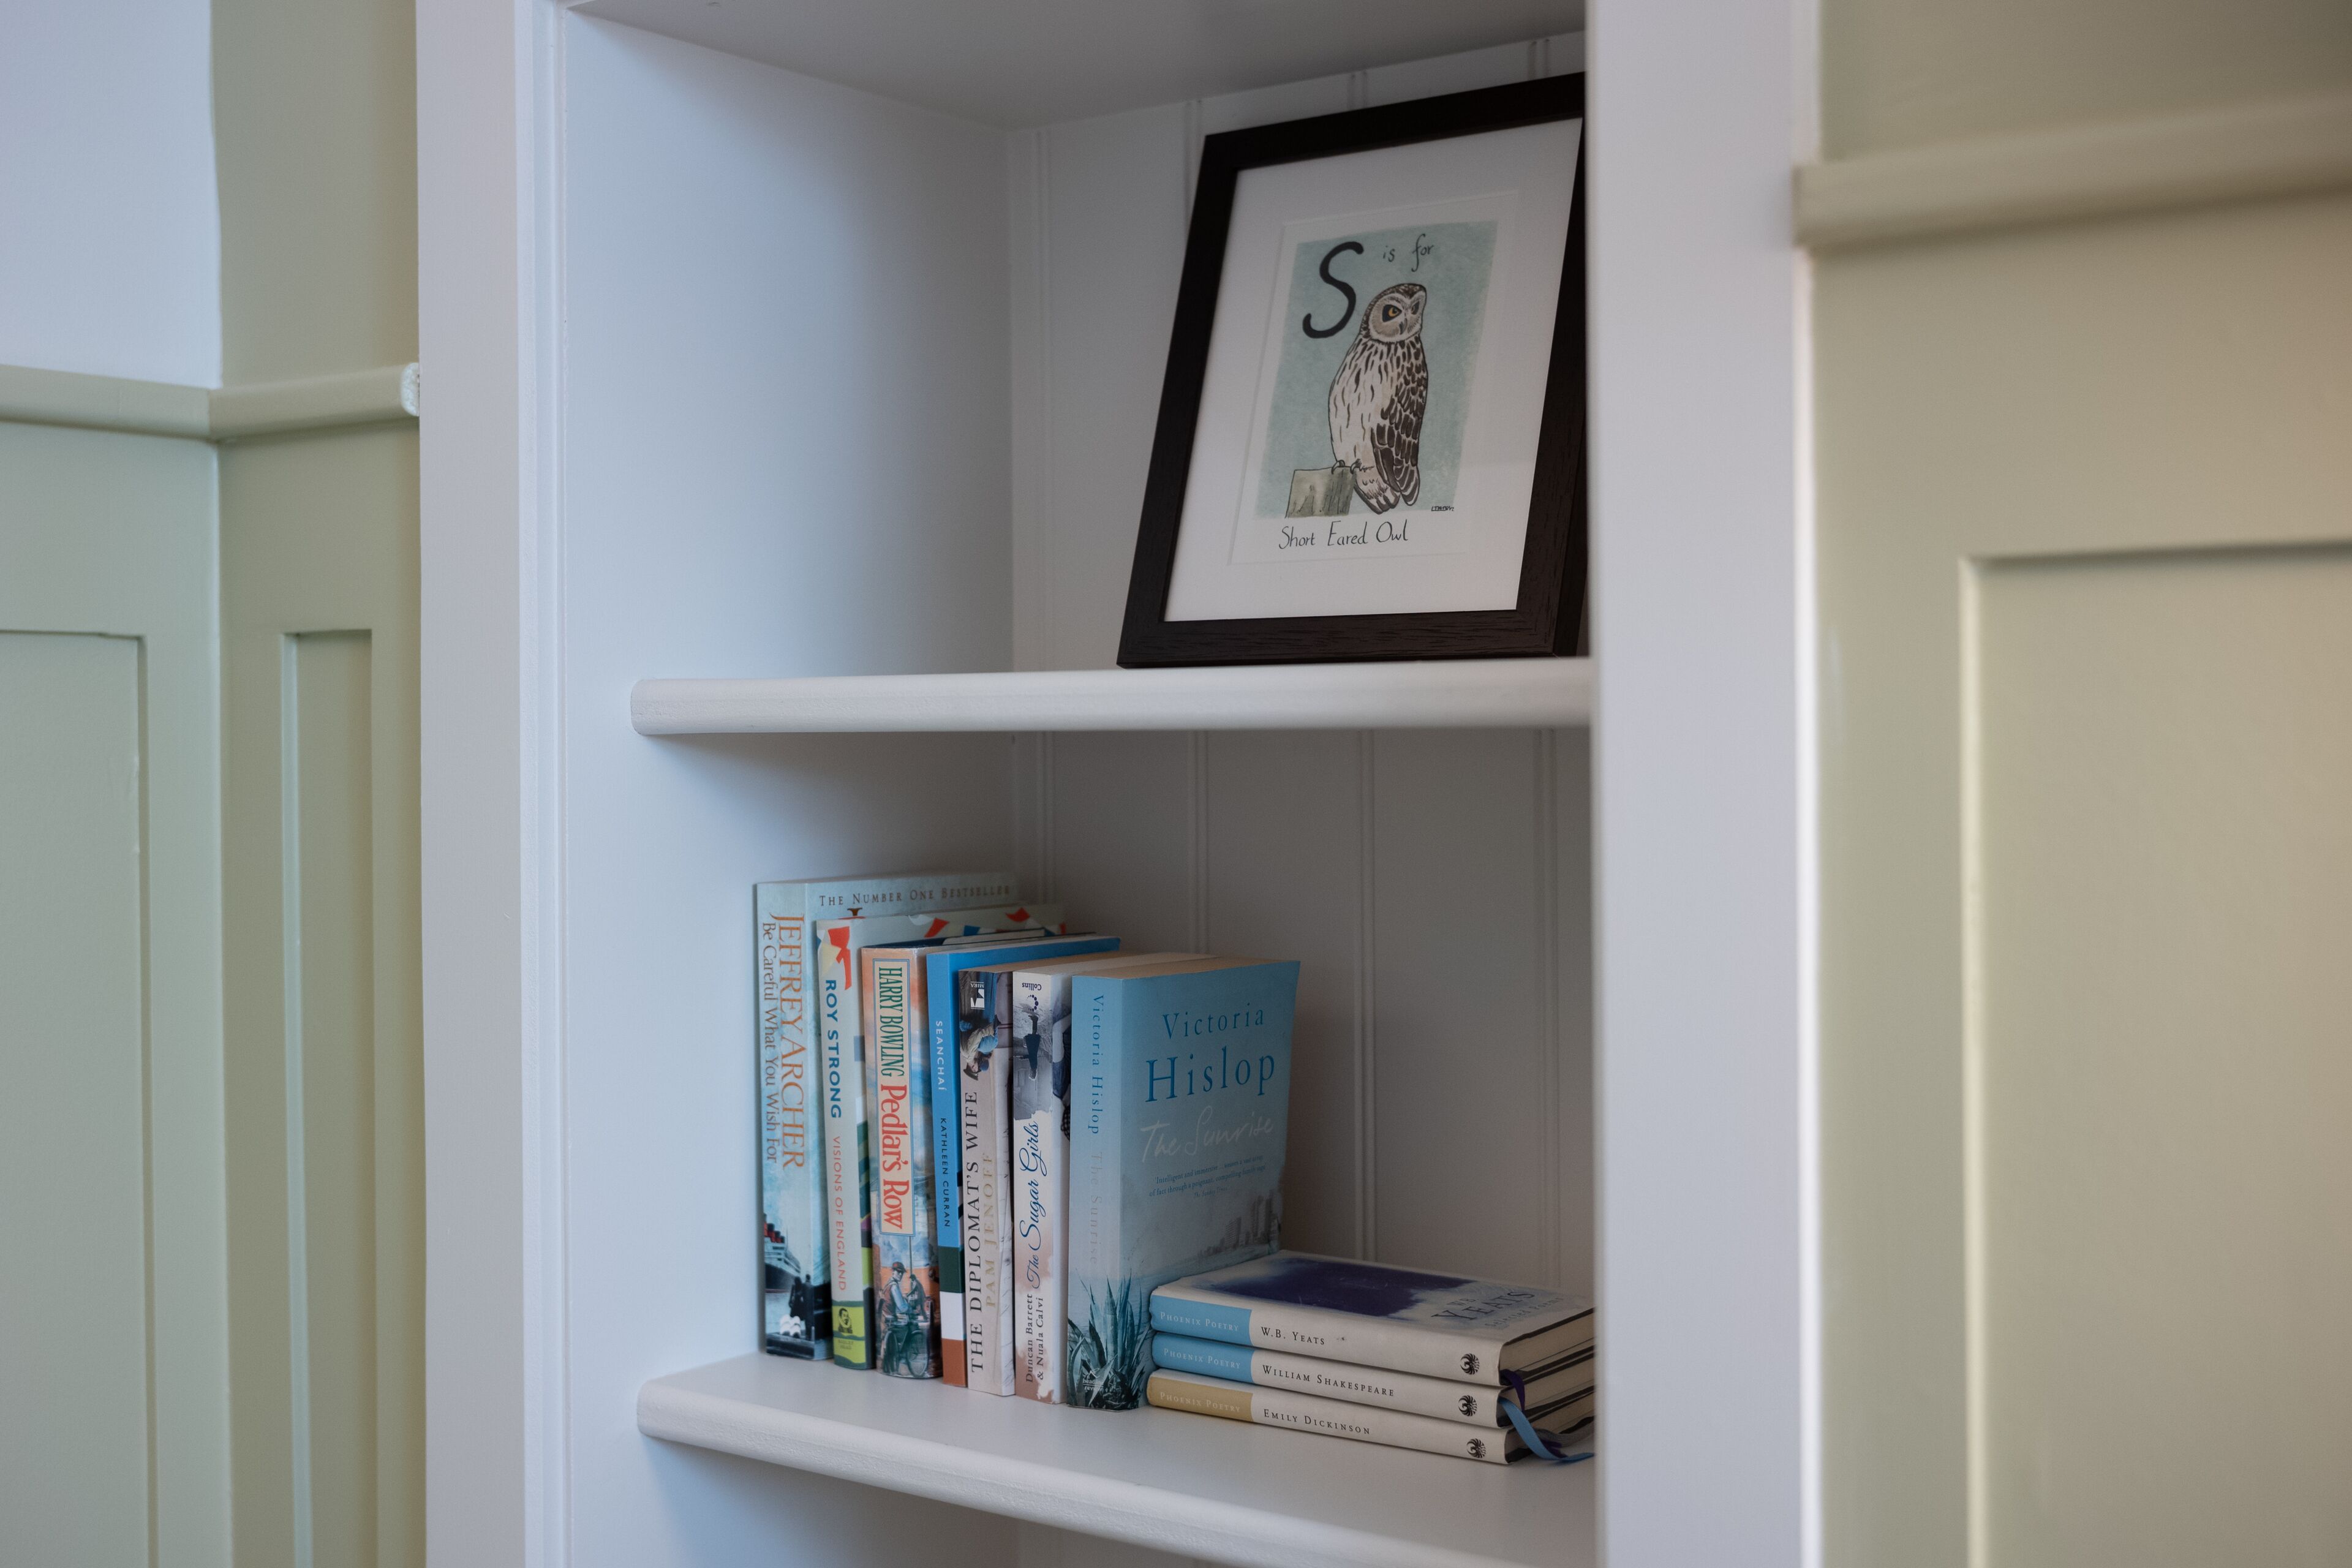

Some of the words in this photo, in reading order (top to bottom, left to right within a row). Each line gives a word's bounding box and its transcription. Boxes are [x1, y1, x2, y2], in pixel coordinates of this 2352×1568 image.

[1302, 241, 1364, 339] S
[1383, 246, 1395, 262] is
[1412, 234, 1434, 272] for
[1279, 526, 1316, 549] Short
[1327, 521, 1368, 546] Eared
[1376, 520, 1409, 542] Owl
[819, 895, 843, 906] THE
[853, 892, 902, 904] NUMBER
[910, 889, 934, 900] ONE
[941, 886, 1010, 899] BESTSELLER
[763, 923, 776, 941] Be
[763, 945, 778, 1001] Careful
[769, 912, 805, 1034] JEFFREY
[879, 967, 903, 1012] HARRY
[1022, 982, 1042, 991] Collins
[826, 980, 838, 1022] ROY
[1163, 1003, 1264, 1039] Victoria
[764, 1008, 779, 1050] What
[880, 1014, 905, 1077] BOWLING
[1093, 994, 1104, 1065] Victoria
[766, 1055, 778, 1086] You
[827, 1030, 842, 1118] STRONG
[936, 1020, 946, 1090] SEANCHAÍ
[1145, 1046, 1275, 1102] Hislop
[766, 1093, 780, 1131] Wish
[781, 1036, 806, 1170] ARCHER
[965, 1091, 978, 1151] WIFE
[1088, 1077, 1103, 1134] Hislop
[767, 1138, 780, 1163] For
[881, 1084, 909, 1172] Pedlar's
[1019, 1121, 1047, 1177] Girls
[1140, 1120, 1181, 1163] The
[1185, 1105, 1273, 1156] Sunrise
[832, 1136, 842, 1191] VISIONS
[1091, 1152, 1102, 1185] The
[835, 1197, 843, 1215] OF
[883, 1179, 910, 1229] Row
[983, 1153, 998, 1249] JENOFF
[1149, 1188, 1156, 1197] of
[1167, 1182, 1187, 1193] through
[967, 1161, 982, 1312] DIPLOMAT'S
[1020, 1179, 1046, 1251] Sugar
[1090, 1196, 1102, 1264] Sunrise
[836, 1221, 846, 1291] ENGLAND
[1027, 1254, 1040, 1289] The
[984, 1260, 996, 1307] PAM
[1431, 1292, 1536, 1320] YEATS
[1161, 1312, 1200, 1325] PHOENIX
[1205, 1319, 1239, 1332] POETRY
[1261, 1327, 1286, 1339] W.B.
[1292, 1332, 1325, 1344] YEATS
[970, 1324, 983, 1373] THE
[1164, 1348, 1203, 1363] PHOENIX
[1208, 1355, 1240, 1369] POETRY
[1037, 1371, 1043, 1380] &
[1262, 1365, 1311, 1382] WILLIAM
[1317, 1374, 1394, 1396] SHAKESPEARE
[1160, 1392, 1202, 1406] PHOENIX
[1207, 1400, 1240, 1412] POETRY
[1264, 1409, 1297, 1422] EMILY
[1305, 1415, 1370, 1434] DICKINSON
